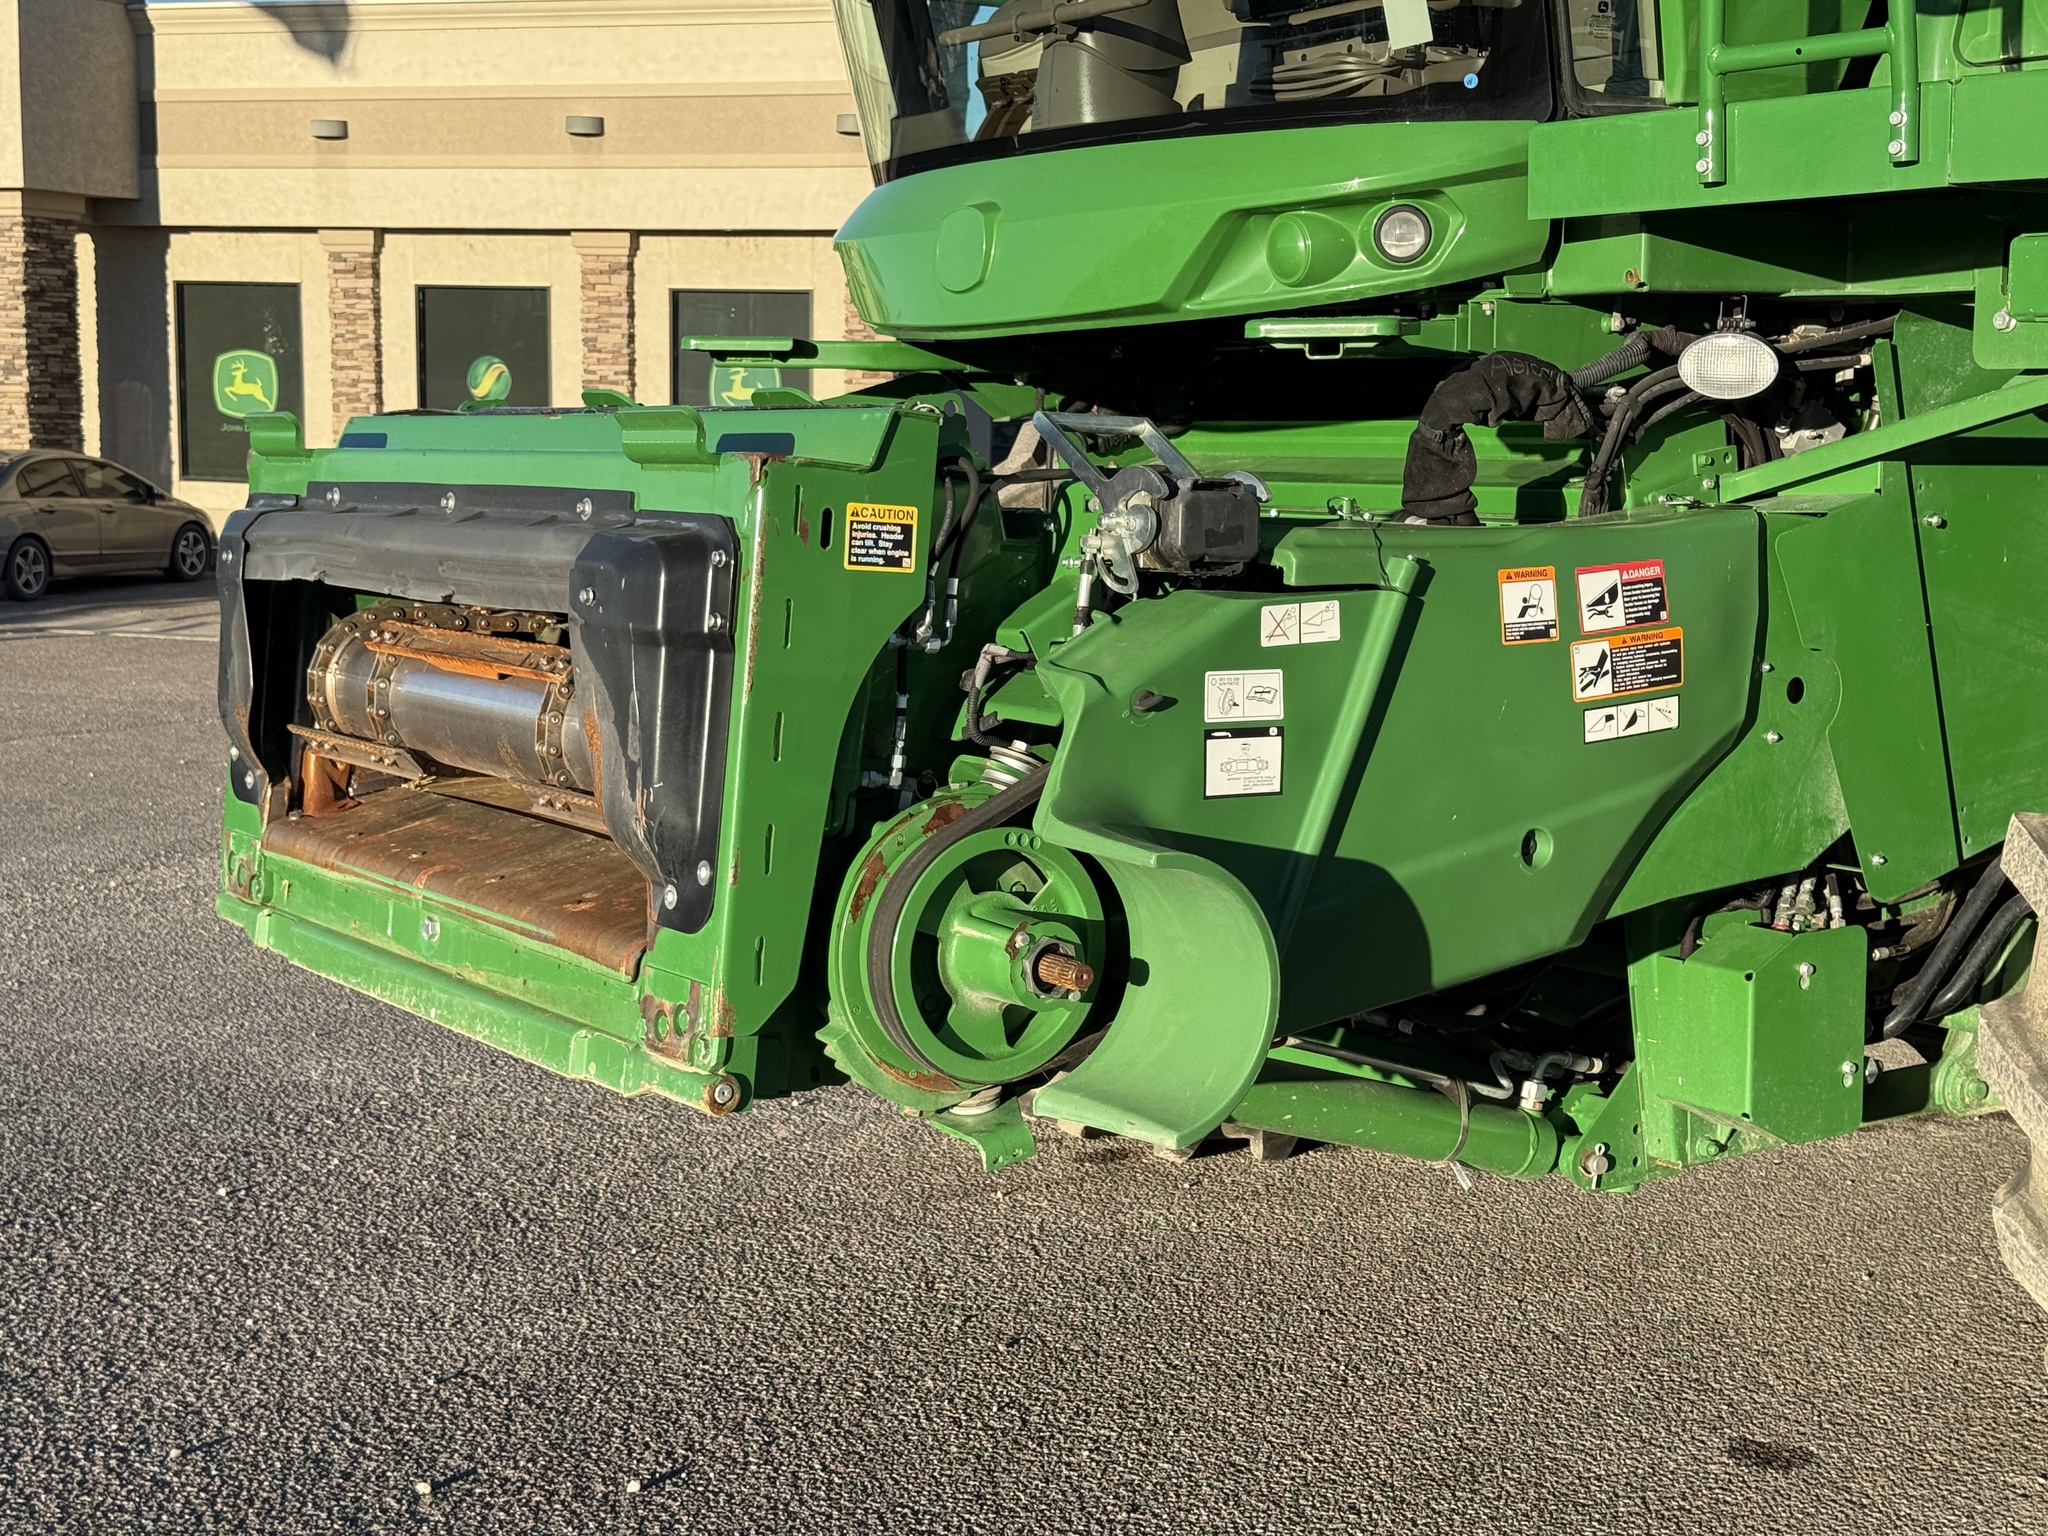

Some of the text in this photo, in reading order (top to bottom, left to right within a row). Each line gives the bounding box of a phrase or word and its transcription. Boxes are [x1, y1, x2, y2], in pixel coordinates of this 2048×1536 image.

[860, 507, 914, 520] CAUTION
[852, 522, 901, 533] Avoid crushing
[881, 532, 904, 540] Header
[878, 540, 893, 549] Stay
[887, 549, 909, 557] engine
[858, 556, 885, 565] running.
[1514, 569, 1548, 578] WARNING
[1628, 566, 1661, 578] DANGER
[1630, 632, 1664, 643] WARNING
